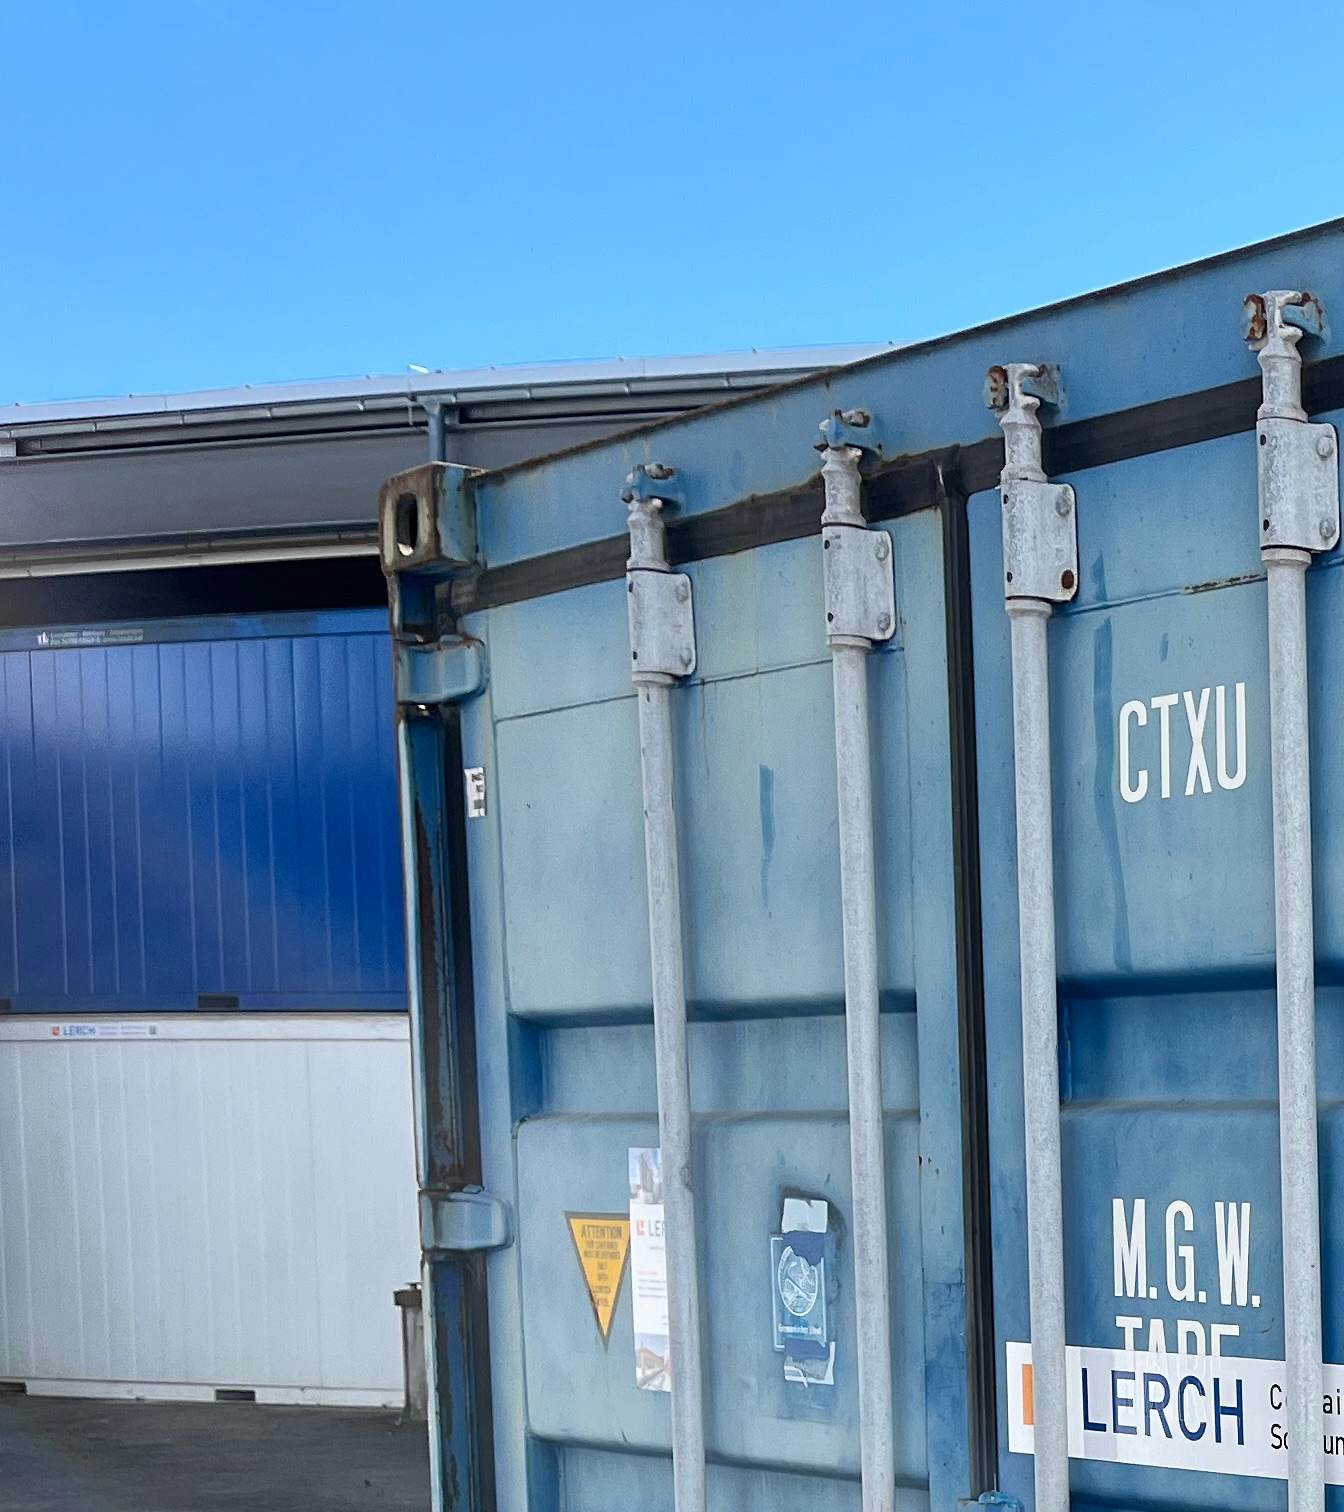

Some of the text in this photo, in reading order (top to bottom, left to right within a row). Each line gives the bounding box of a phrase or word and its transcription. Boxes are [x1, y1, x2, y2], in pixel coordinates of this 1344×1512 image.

[1119, 682, 1247, 803] CTXU
[1112, 1198, 1261, 1308] M.G.W.
[1081, 1367, 1245, 1446] LERCH
